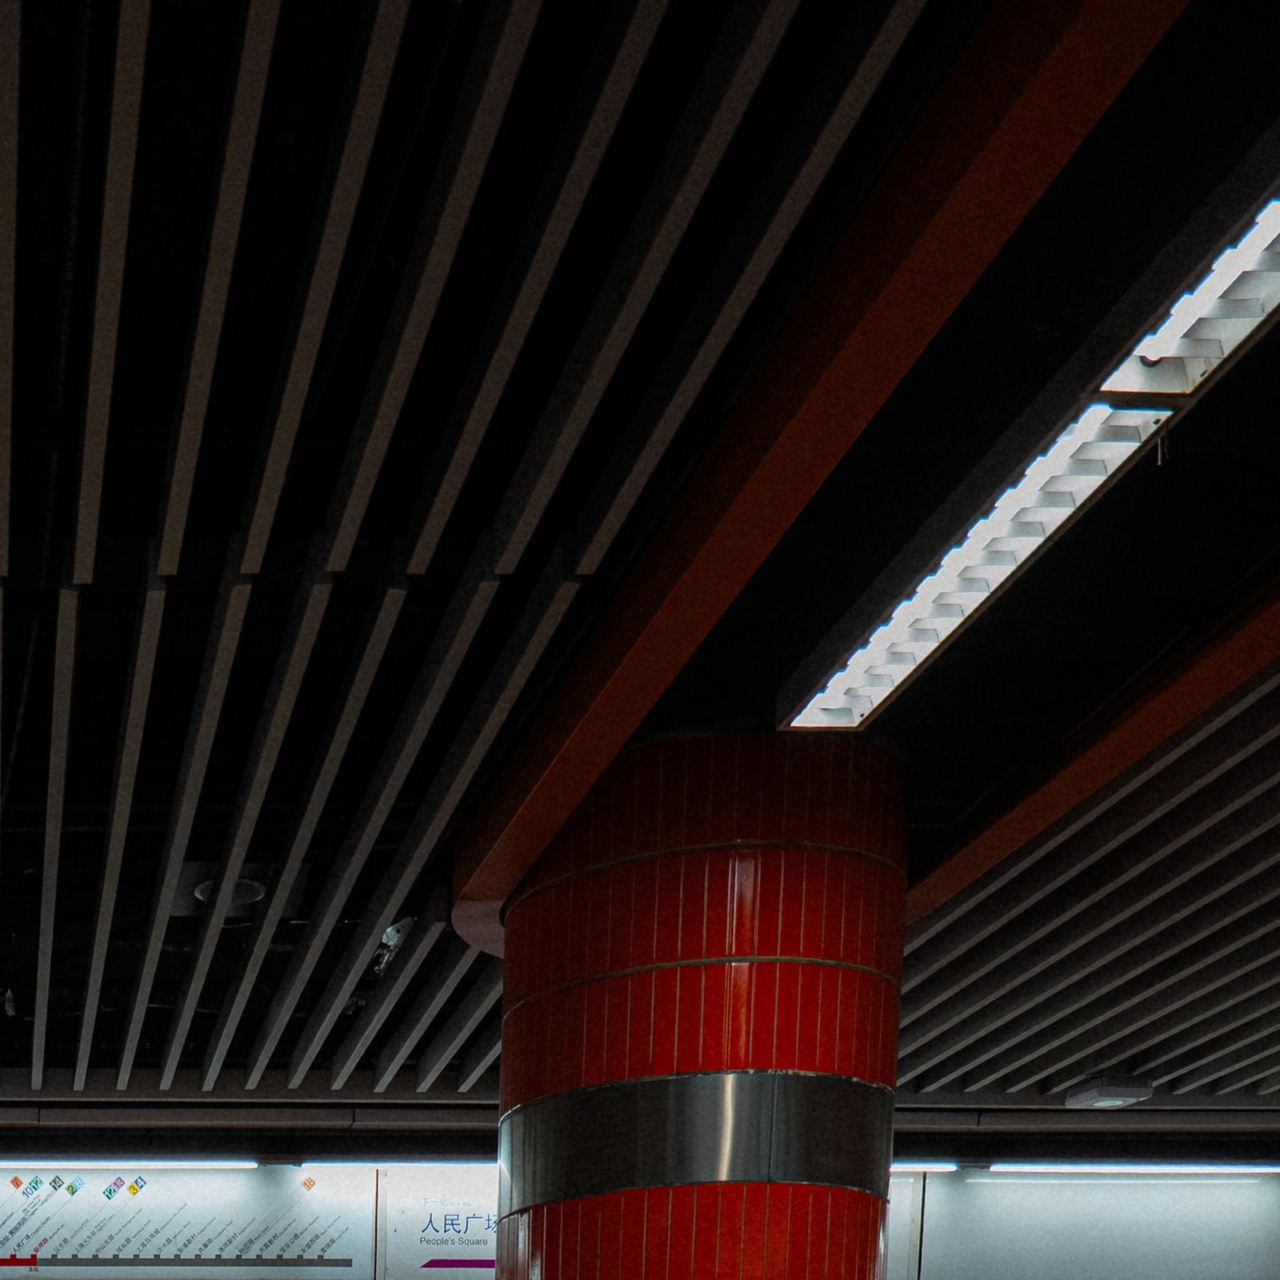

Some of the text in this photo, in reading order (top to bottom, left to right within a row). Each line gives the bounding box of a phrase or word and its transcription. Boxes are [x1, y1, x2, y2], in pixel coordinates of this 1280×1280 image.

[23, 1178, 42, 1198] 10 12
[51, 1178, 62, 1189] 14
[68, 1179, 83, 1194] 2 8
[105, 1178, 124, 1198] 12 13
[129, 1178, 145, 1195] 3 4
[303, 1177, 315, 1190] 18
[419, 1237, 488, 1247] People's Square
